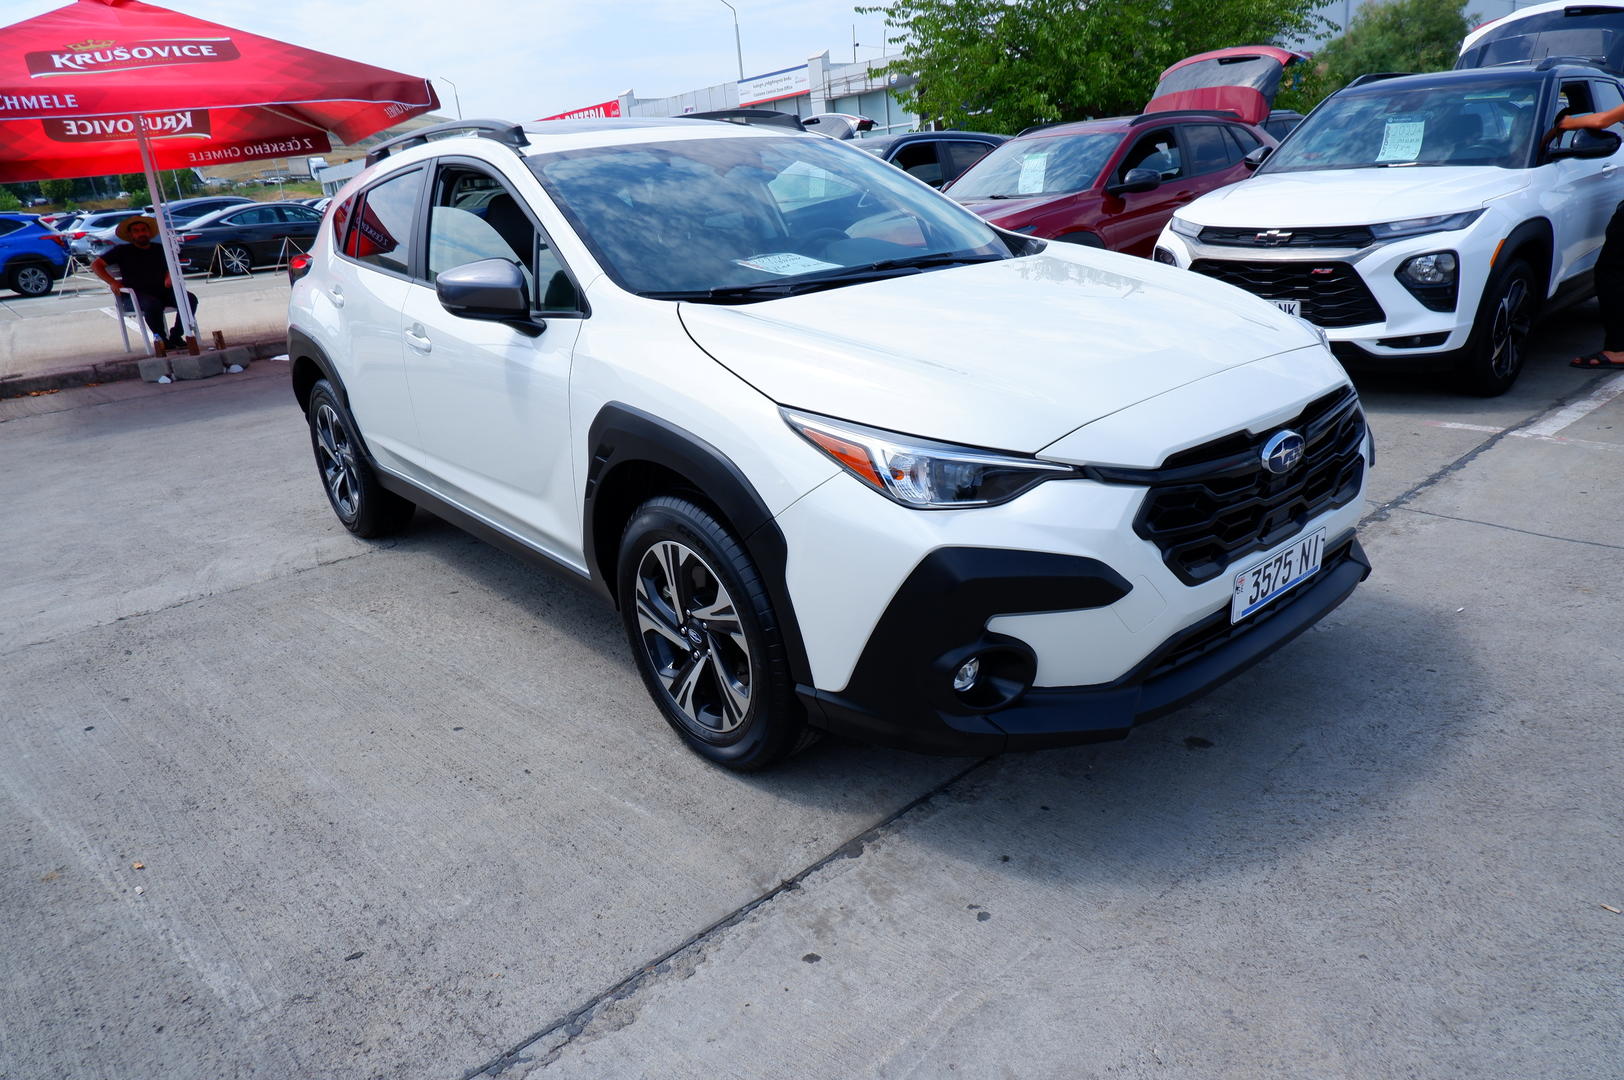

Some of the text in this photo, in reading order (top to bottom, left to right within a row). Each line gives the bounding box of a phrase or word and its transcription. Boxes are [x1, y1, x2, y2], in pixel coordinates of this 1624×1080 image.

[51, 45, 218, 70] KRUŠOVICE
[1248, 534, 1320, 605] 3575 NI
